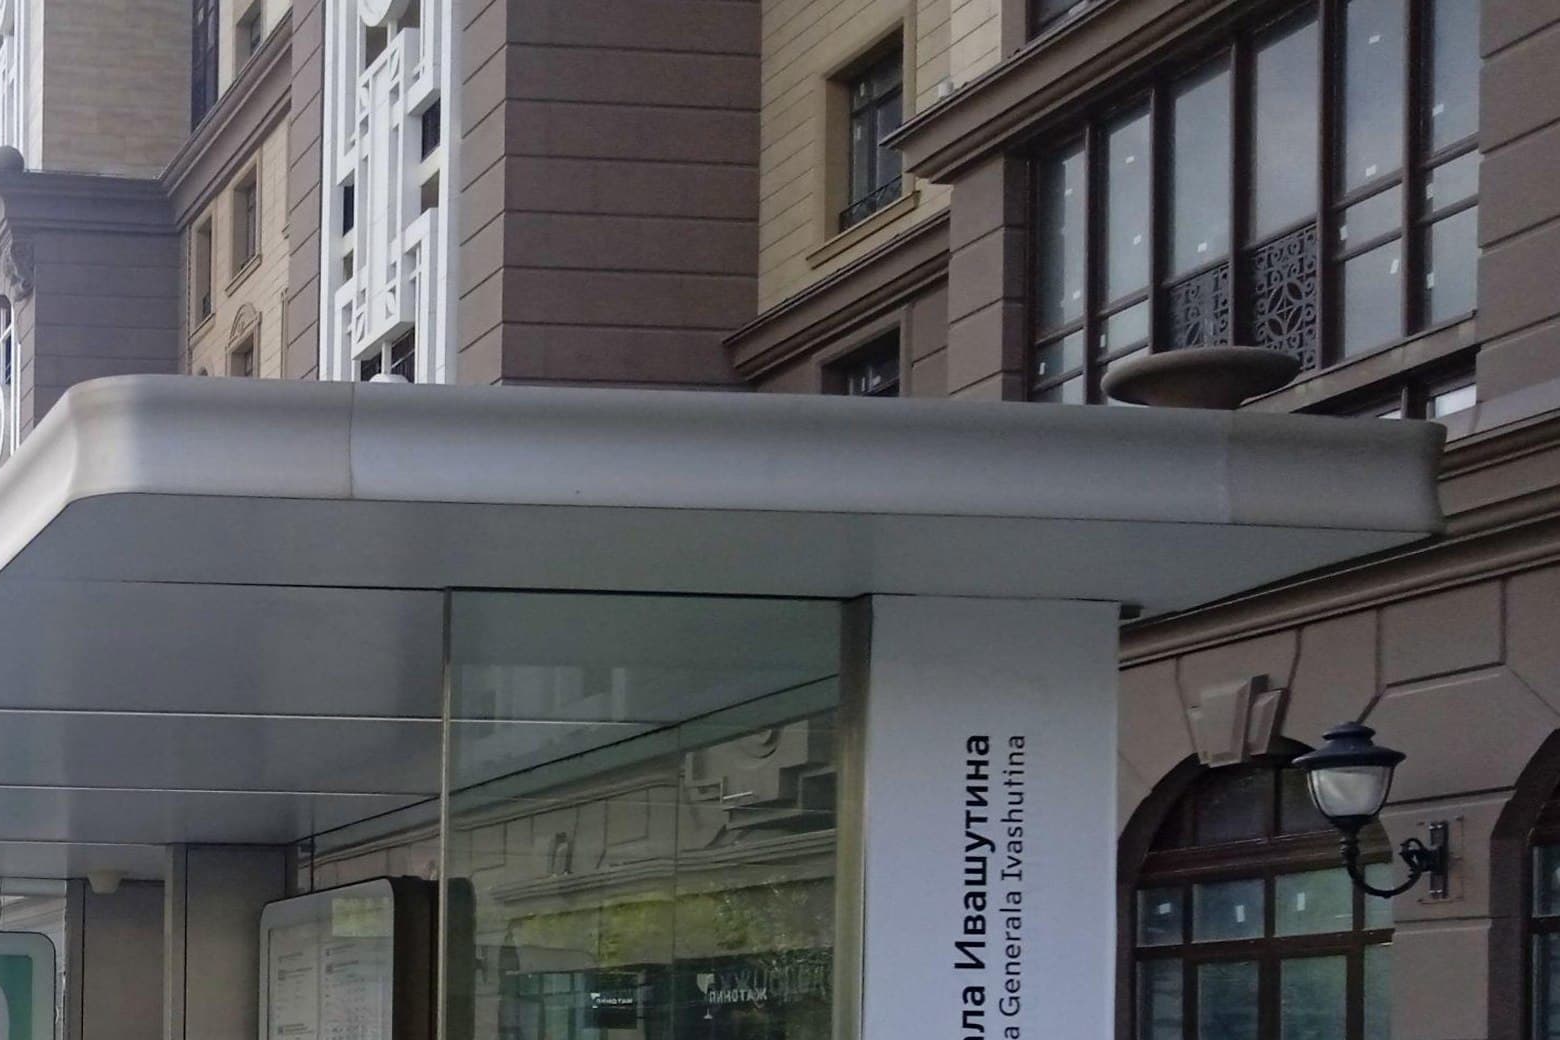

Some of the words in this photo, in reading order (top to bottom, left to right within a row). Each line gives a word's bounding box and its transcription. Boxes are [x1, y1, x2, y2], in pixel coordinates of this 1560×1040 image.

[954, 734, 996, 969] Ивашутина
[1000, 735, 1027, 882] Ivashutina
[998, 891, 1023, 1017] Generala
